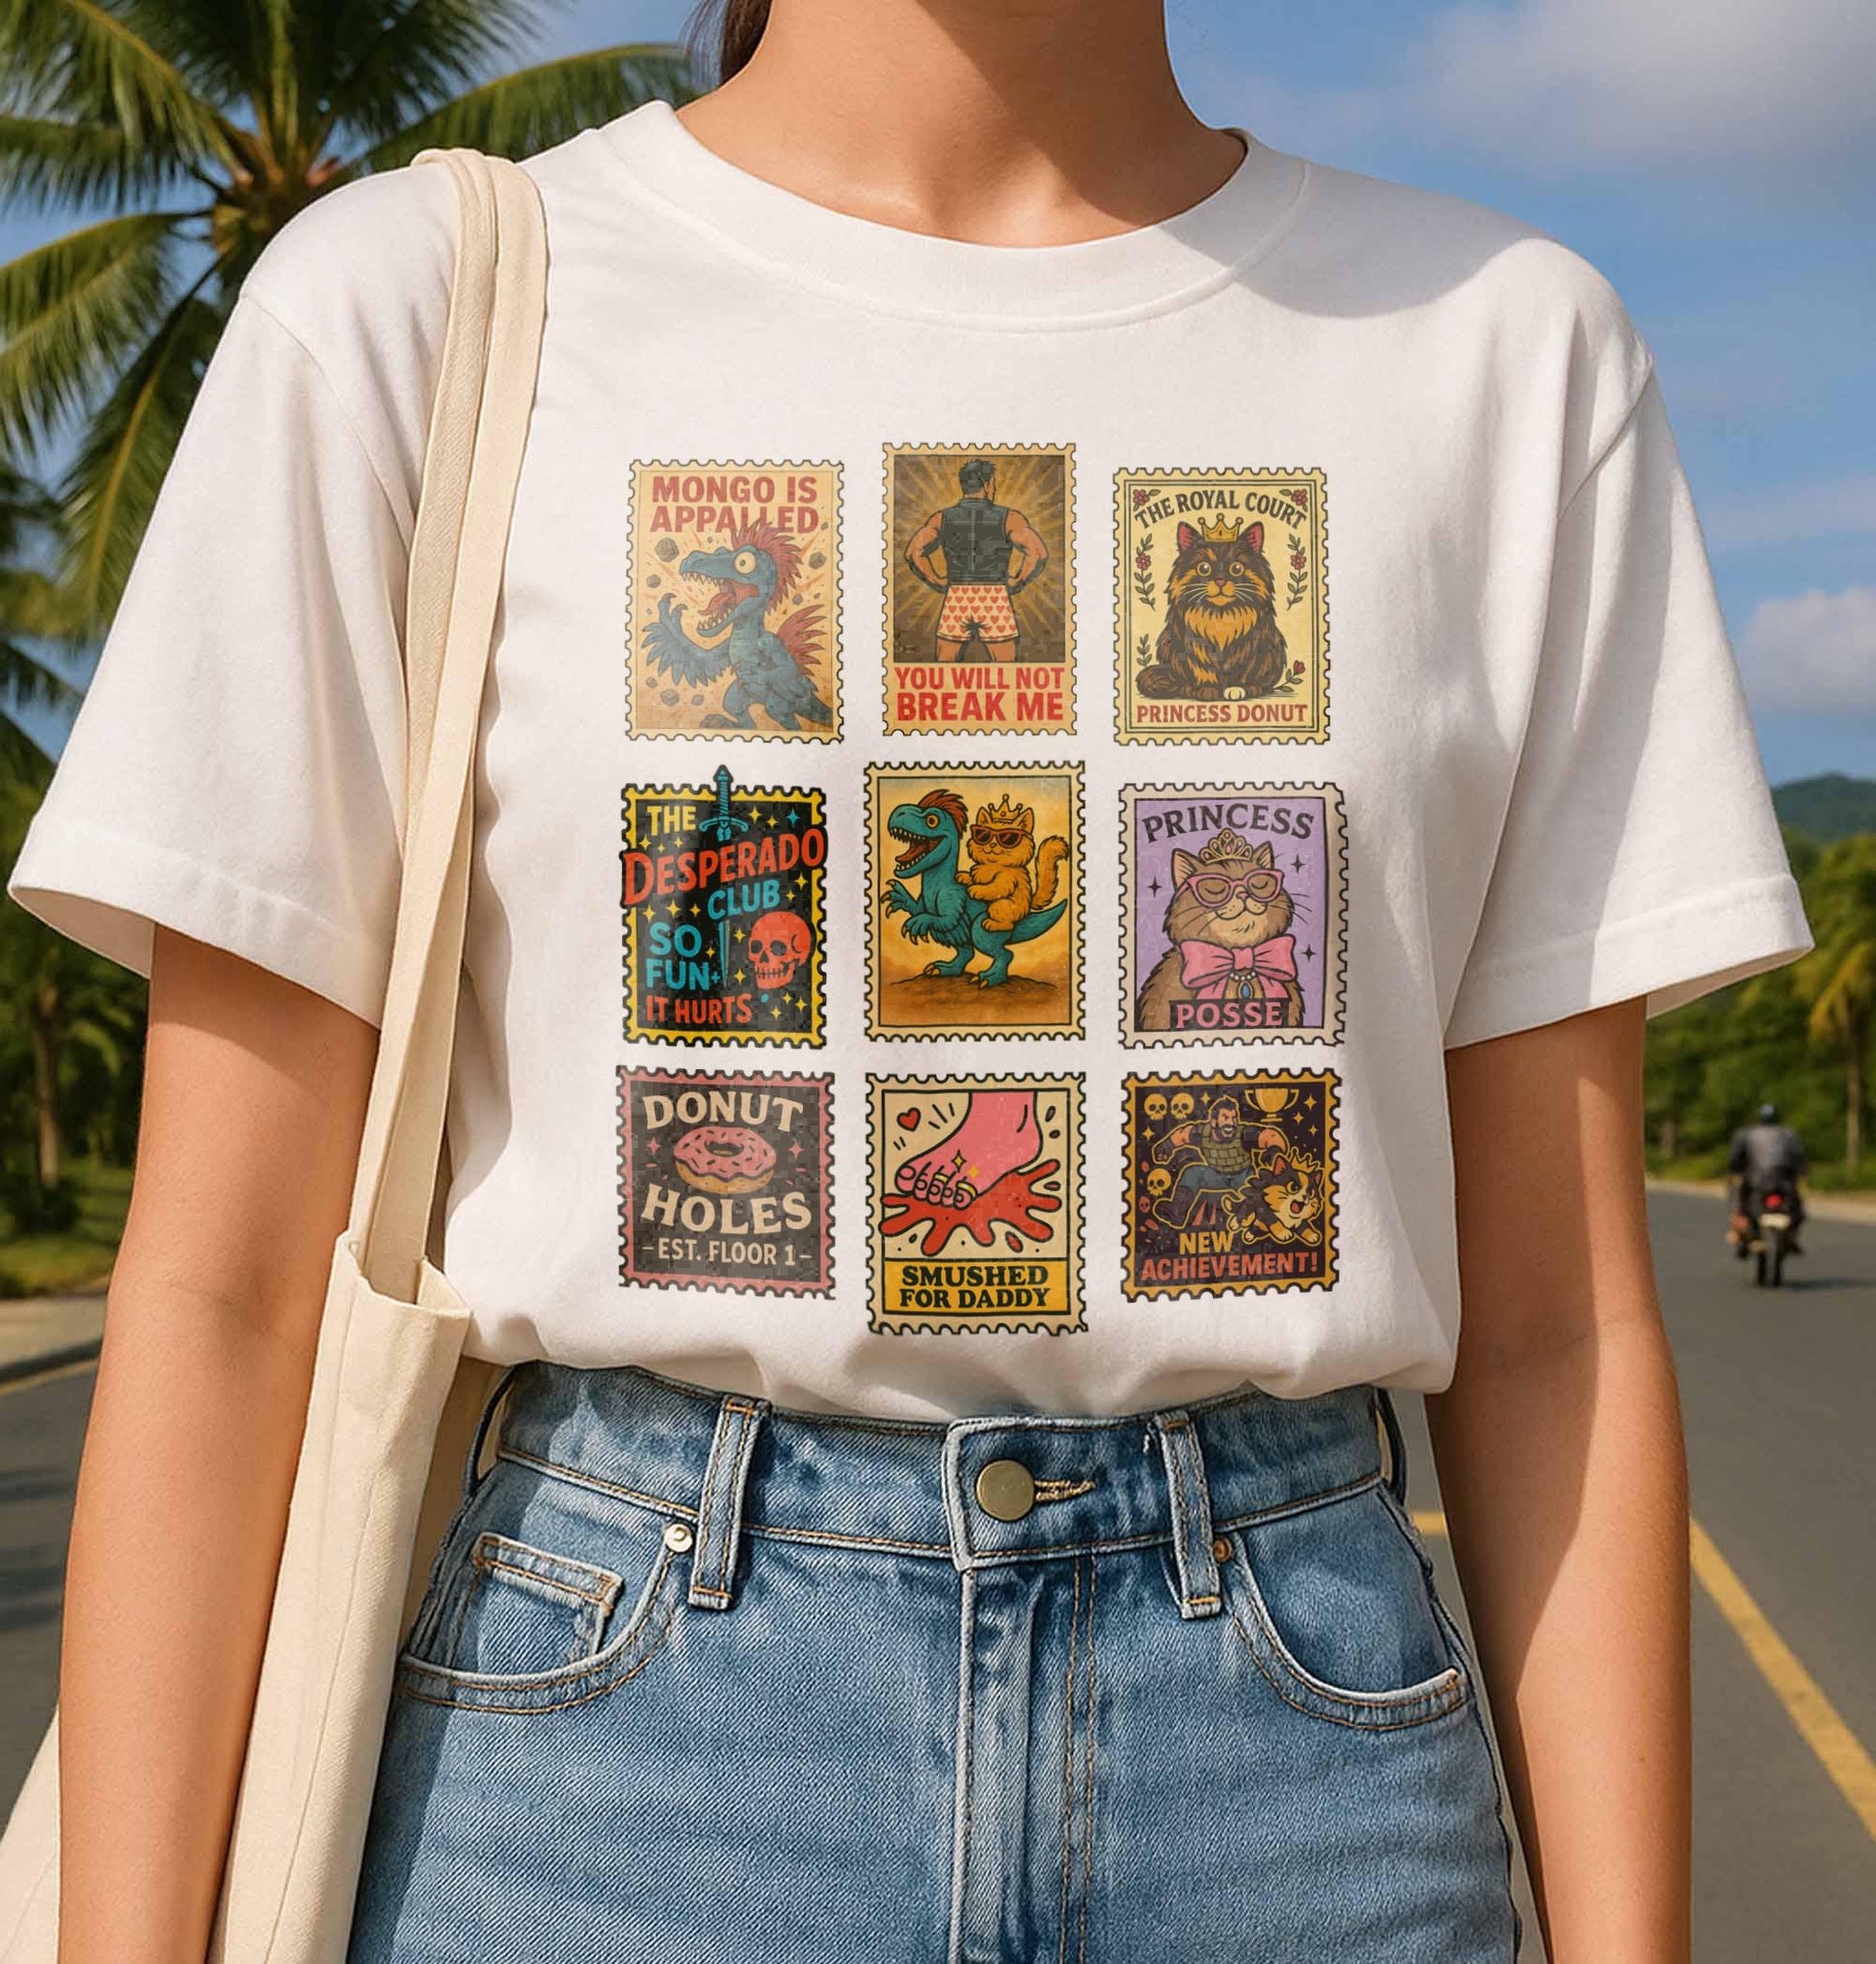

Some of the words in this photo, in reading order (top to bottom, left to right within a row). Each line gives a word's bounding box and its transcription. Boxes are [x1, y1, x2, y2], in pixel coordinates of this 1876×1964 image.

[652, 476, 775, 503] MONGO
[787, 476, 817, 503] IS
[1135, 501, 1175, 530] THE
[1177, 490, 1240, 518] ROYAL
[1245, 492, 1307, 530] COURT
[896, 667, 949, 690] YOU
[951, 667, 1009, 689] WILL
[1016, 667, 1065, 690] NOT
[898, 692, 1005, 721] BREAK
[1017, 692, 1063, 721] ME
[1137, 705, 1231, 723] PRINCESS
[1236, 704, 1308, 723] DONUT
[647, 806, 696, 836] THE
[1141, 803, 1314, 844] PRINCESS
[623, 828, 824, 905] DESPERADO
[708, 879, 780, 920] CLUB
[649, 922, 702, 957] SO
[646, 959, 710, 990] FUN
[646, 995, 668, 1022] IT
[675, 993, 752, 1024] HURTS
[1176, 1002, 1283, 1029] POSSE
[642, 1090, 803, 1132] DONUT
[641, 1183, 812, 1234] HOLES
[709, 1241, 777, 1265] FLOOR
[1180, 1230, 1234, 1254] NEW
[902, 1265, 1049, 1287] SMUSHED
[1140, 1251, 1319, 1280] ACHIEVEMENT!
[899, 1289, 951, 1308] FOR
[958, 1287, 1051, 1308] DADDY
